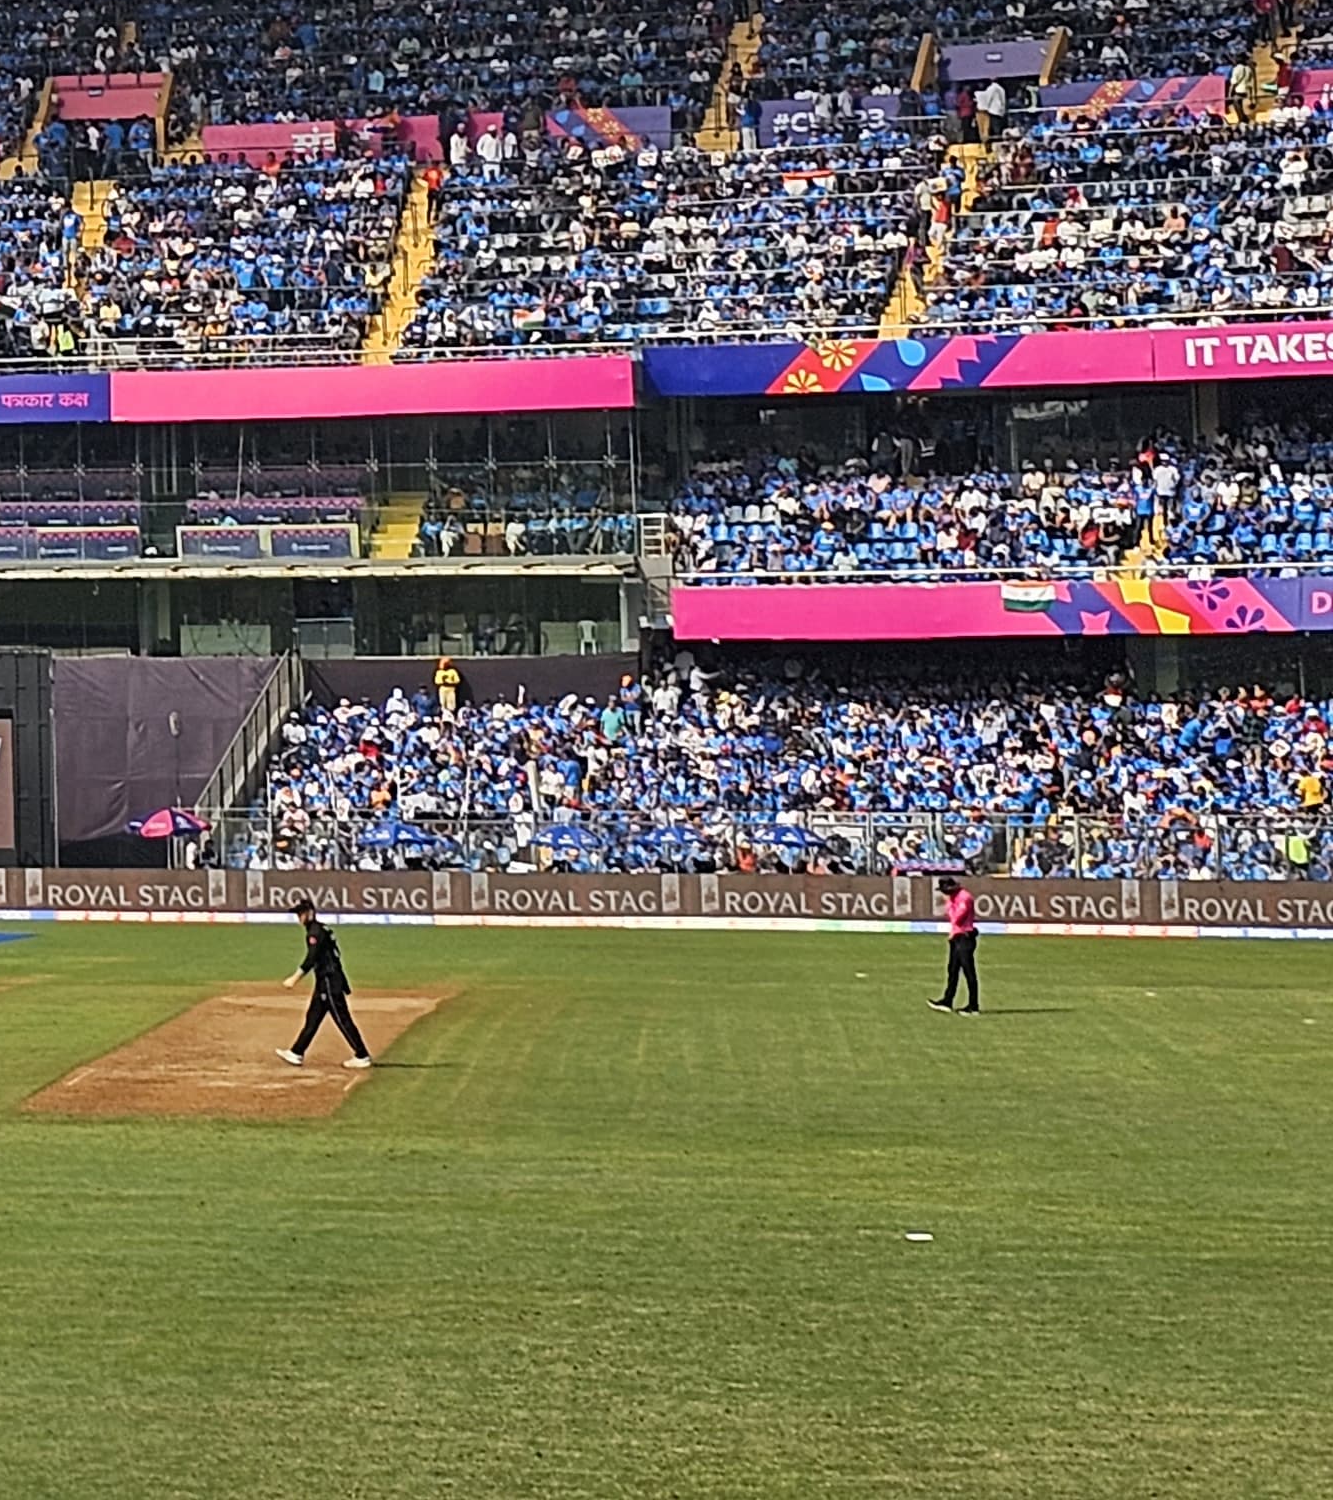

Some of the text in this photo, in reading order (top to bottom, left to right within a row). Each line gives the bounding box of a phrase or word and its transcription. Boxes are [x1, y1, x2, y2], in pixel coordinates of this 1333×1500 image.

[1185, 337, 1220, 367] IT
[48, 884, 204, 907] ROYAL STAG
[269, 887, 428, 909] ROYAL STAG
[494, 889, 657, 911] ROYAL STAG
[724, 891, 889, 916] ROYAL STAG
[974, 894, 1118, 919] OYAL STAG
[1184, 898, 1271, 921] ROYAL
